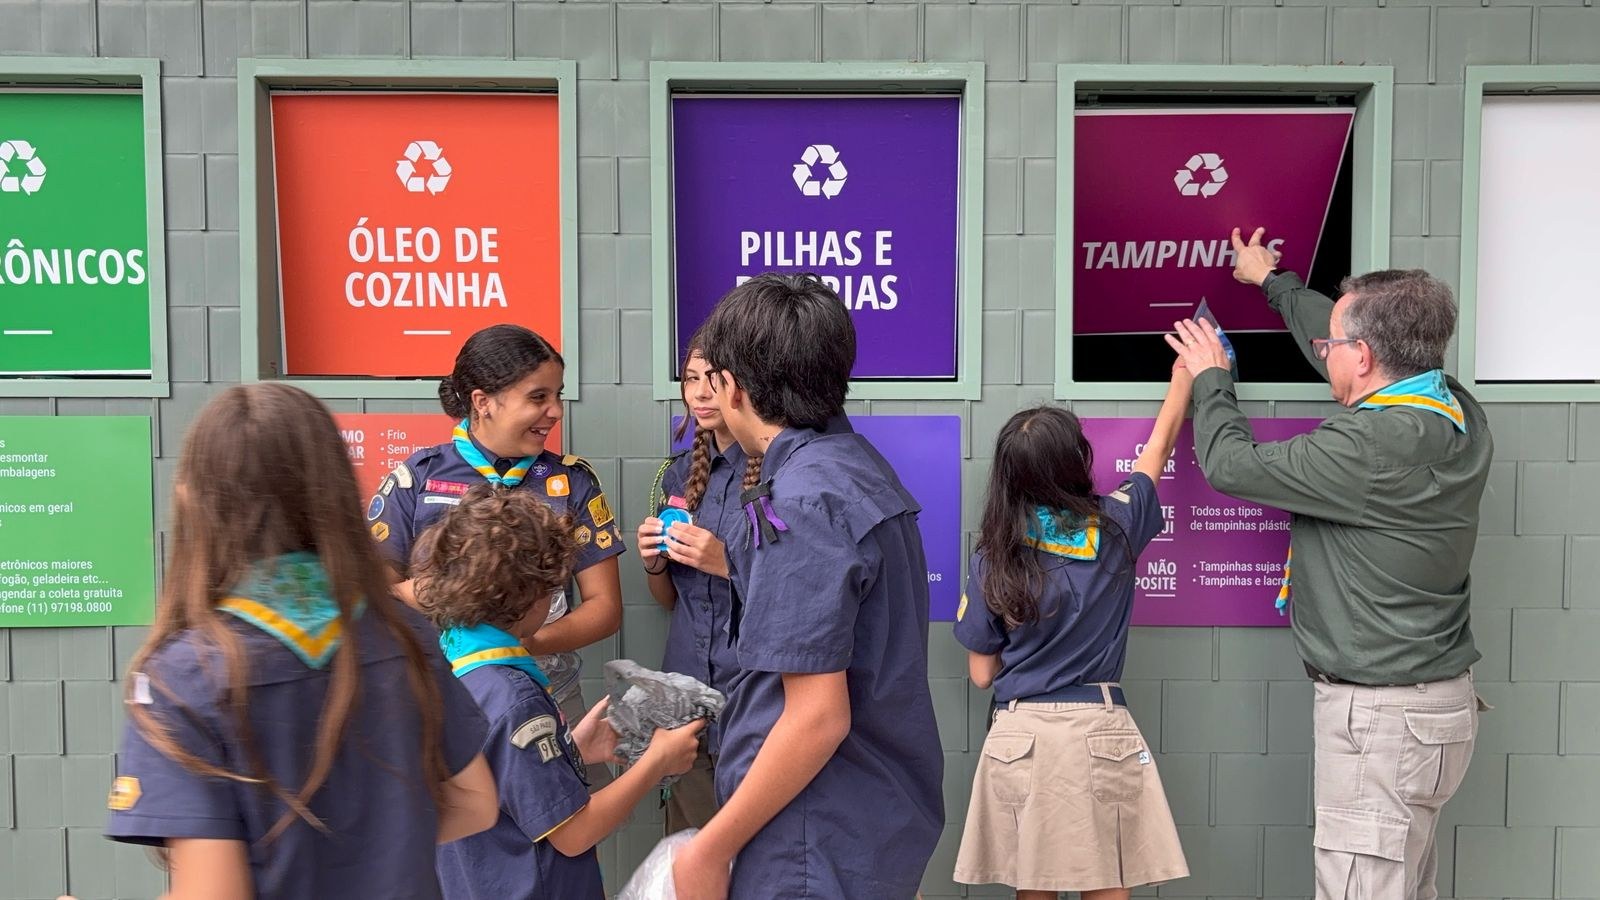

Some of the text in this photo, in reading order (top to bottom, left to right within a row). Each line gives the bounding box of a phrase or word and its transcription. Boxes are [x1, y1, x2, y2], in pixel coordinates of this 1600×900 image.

[348, 216, 499, 263] ÓLEO DE
[740, 230, 893, 267] PILHAS E
[1082, 238, 1285, 270] TAMPINHS
[0, 238, 146, 285] ÔNICOS
[345, 271, 508, 308] COZINHA
[387, 429, 407, 440] Frio
[387, 444, 410, 455] Sem
[29, 504, 45, 513] em
[47, 501, 73, 515] geral
[1190, 505, 1263, 519] Todos os tipos
[1190, 520, 1203, 531] de
[1205, 519, 1257, 533] tampinhas
[51, 559, 93, 570] maiores
[1147, 558, 1177, 576] NÃO
[1199, 561, 1252, 574] Tampinhas
[1255, 562, 1281, 574] sujas
[32, 573, 80, 587] geladeira
[82, 573, 109, 584] etc...
[1199, 575, 1252, 588] Tampinhas
[1254, 577, 1262, 586] e
[39, 590, 46, 599] a
[48, 588, 80, 599] coleta
[83, 587, 123, 601] gratuita
[27, 602, 48, 615] (11)
[50, 602, 113, 613] 97198.0800
